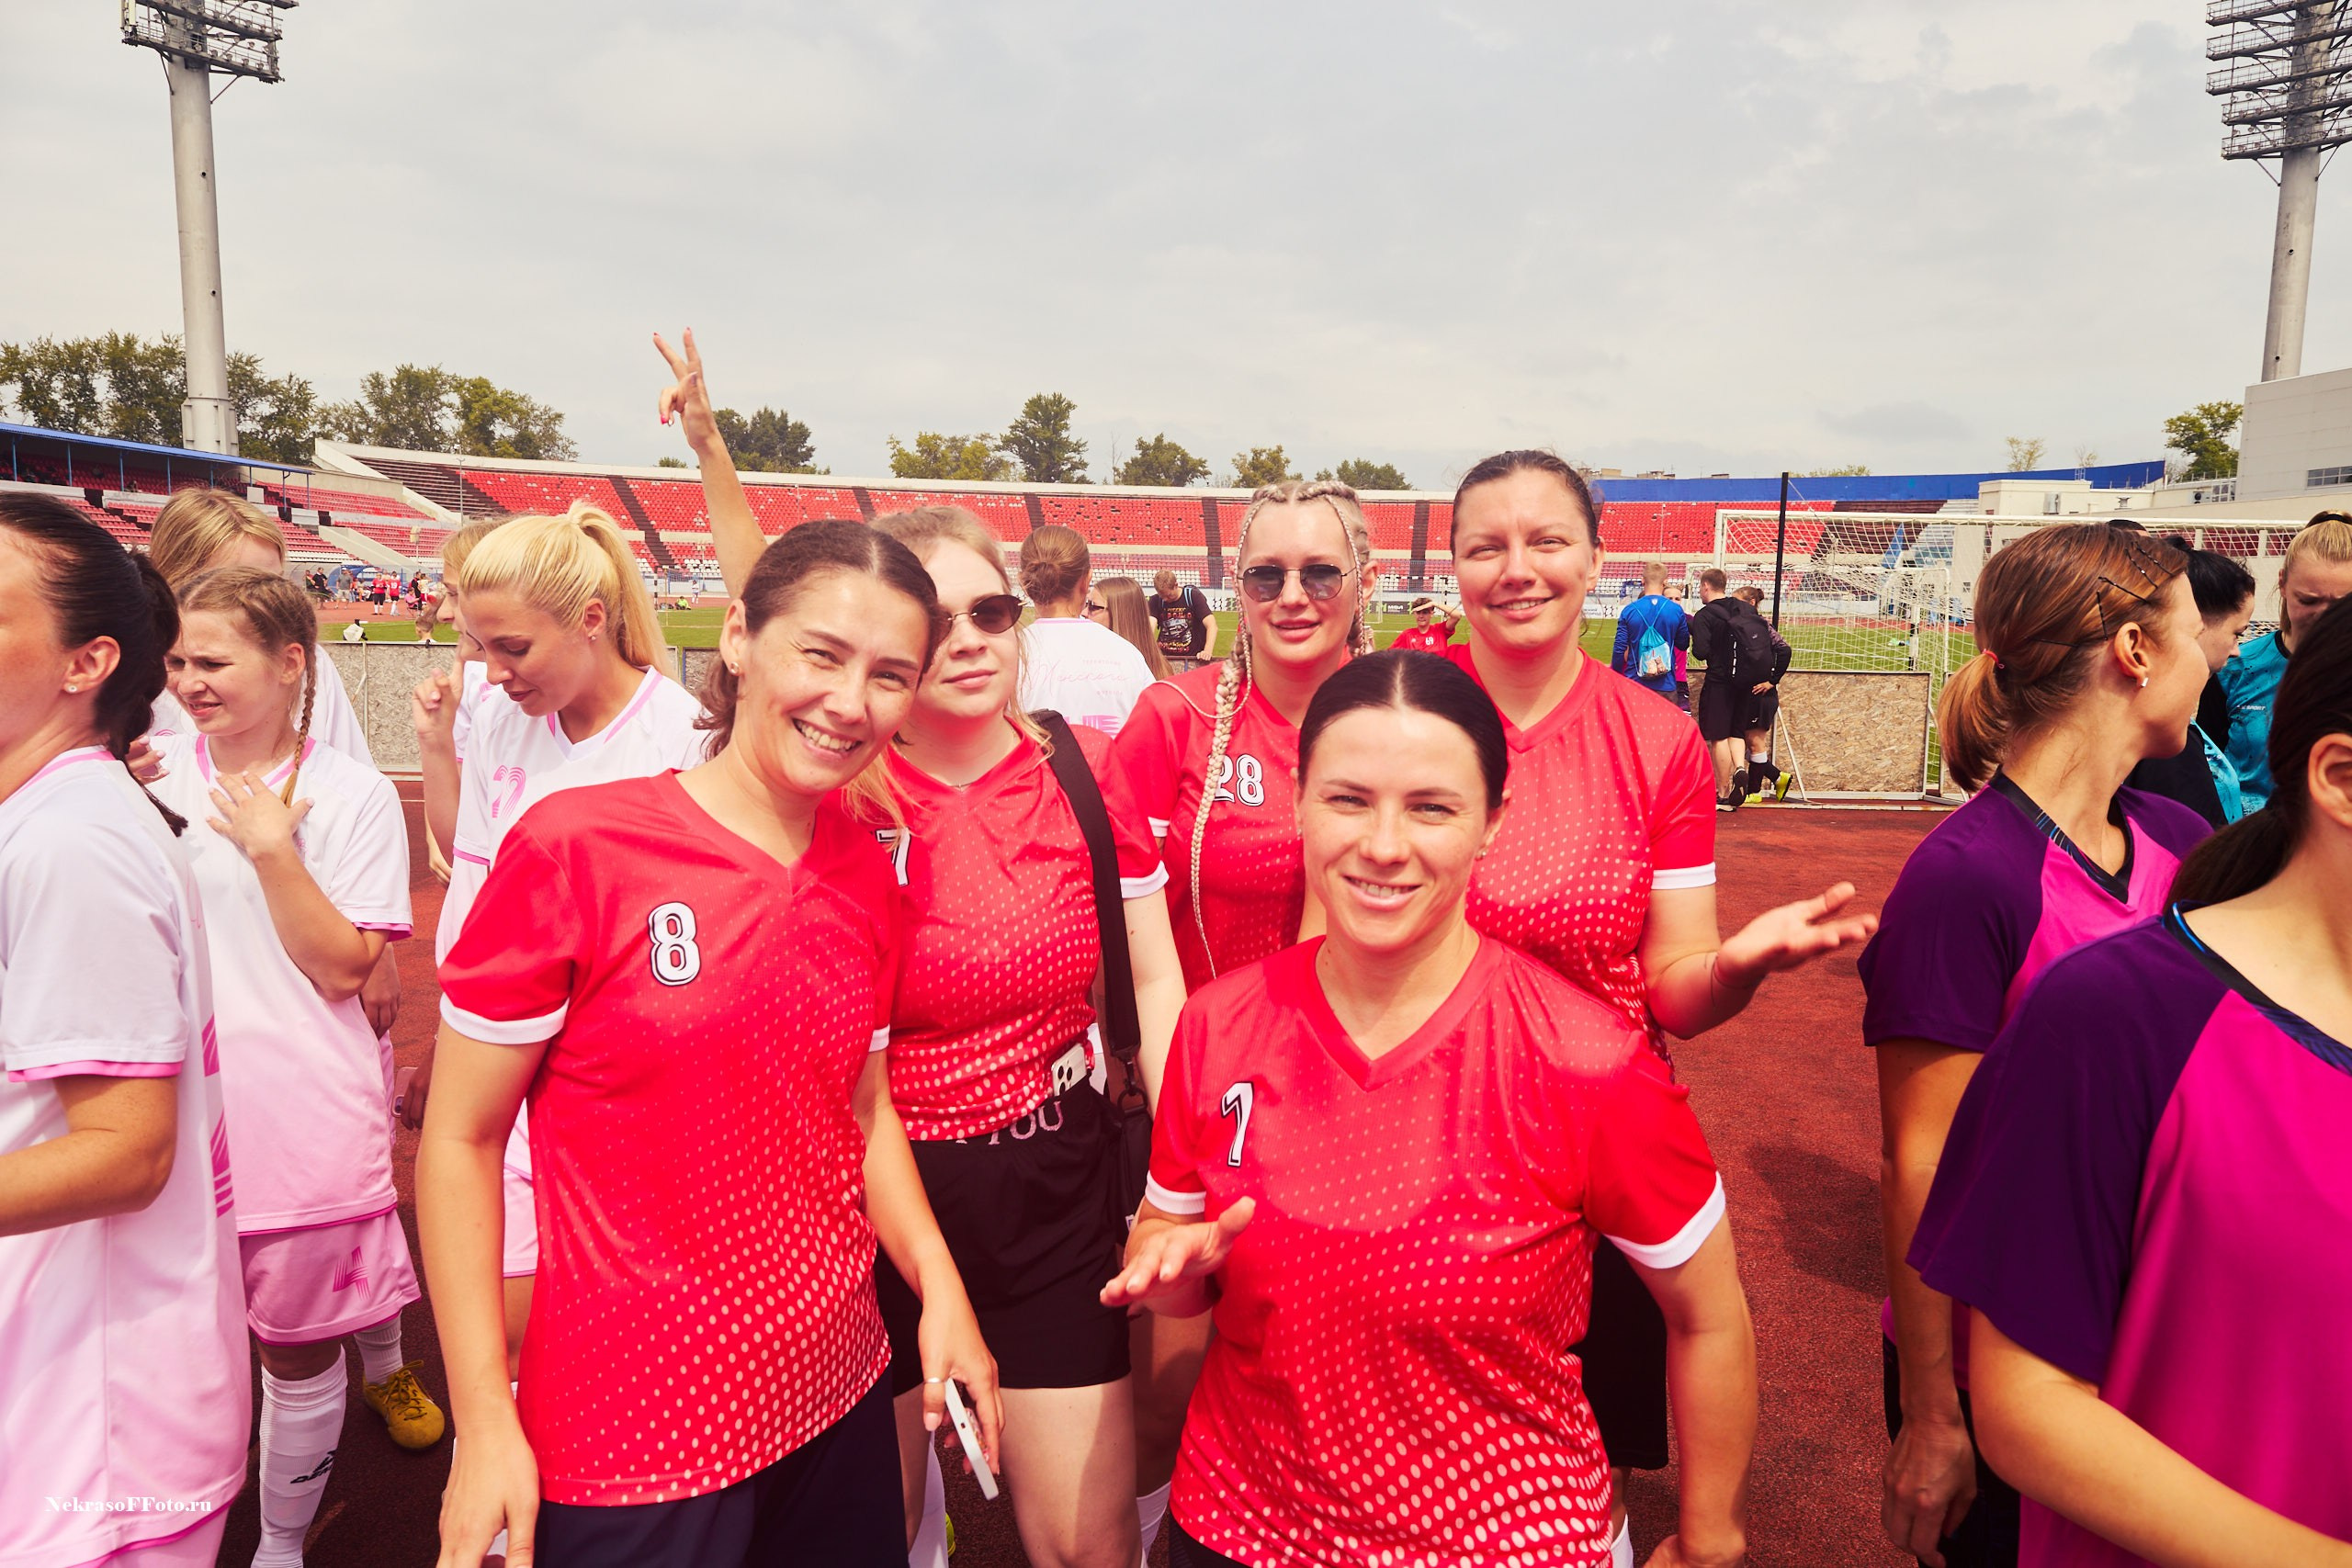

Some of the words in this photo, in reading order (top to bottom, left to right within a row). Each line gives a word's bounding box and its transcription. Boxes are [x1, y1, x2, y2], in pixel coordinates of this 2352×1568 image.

[1207, 752, 1265, 807] 28
[648, 901, 702, 987] 8
[333, 1245, 372, 1302] 4
